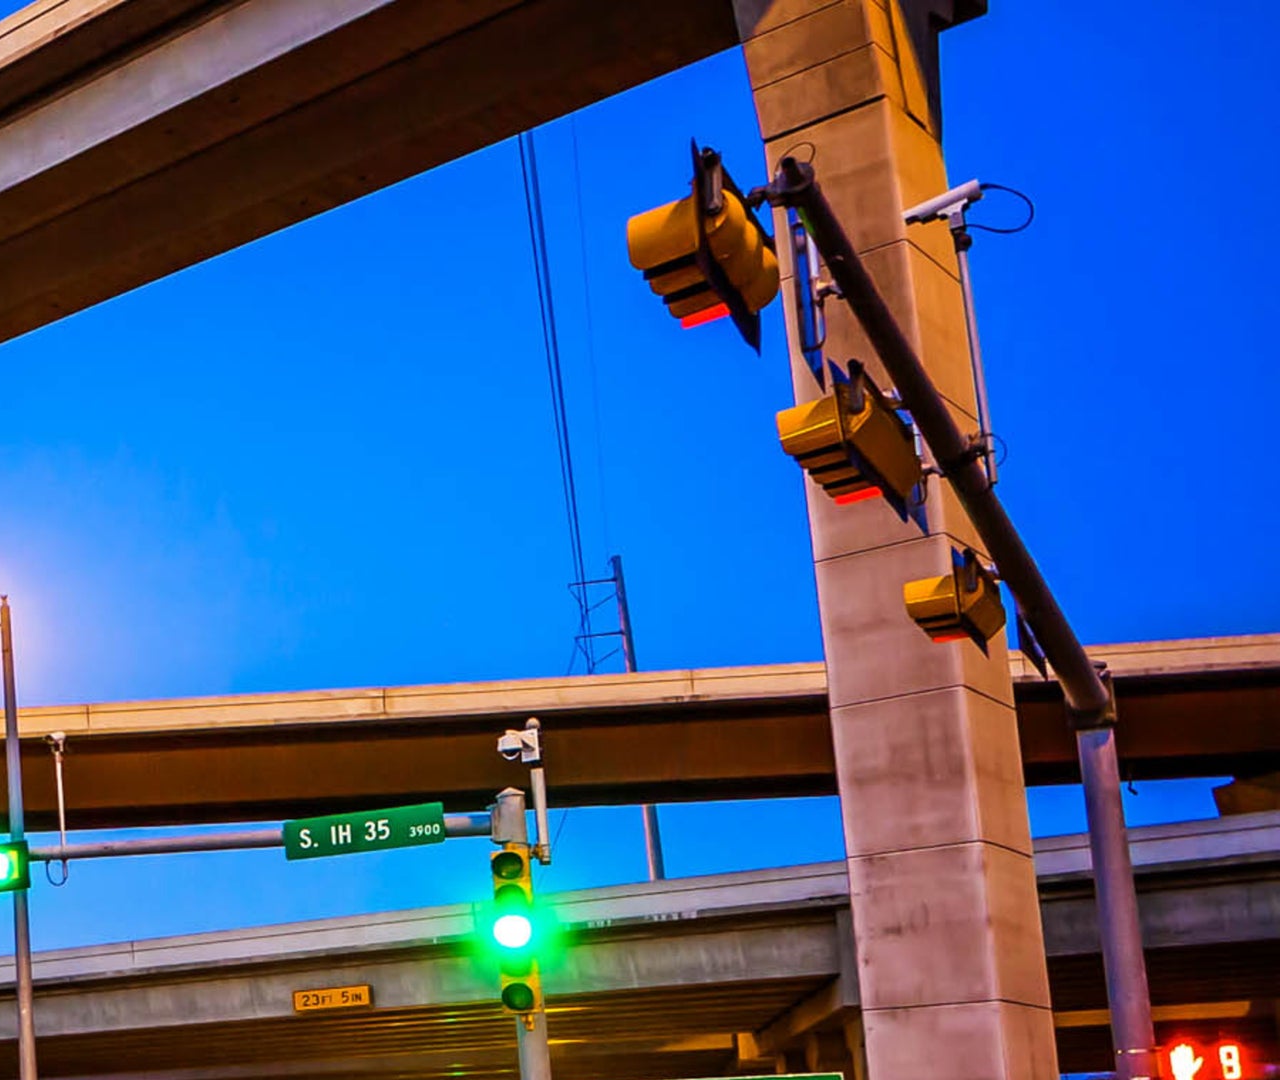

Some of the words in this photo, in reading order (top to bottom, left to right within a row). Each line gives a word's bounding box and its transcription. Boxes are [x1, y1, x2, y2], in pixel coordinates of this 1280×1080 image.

[299, 829, 319, 849] S.
[330, 824, 352, 845] IH
[364, 819, 390, 841] 35
[409, 823, 441, 838] 3900
